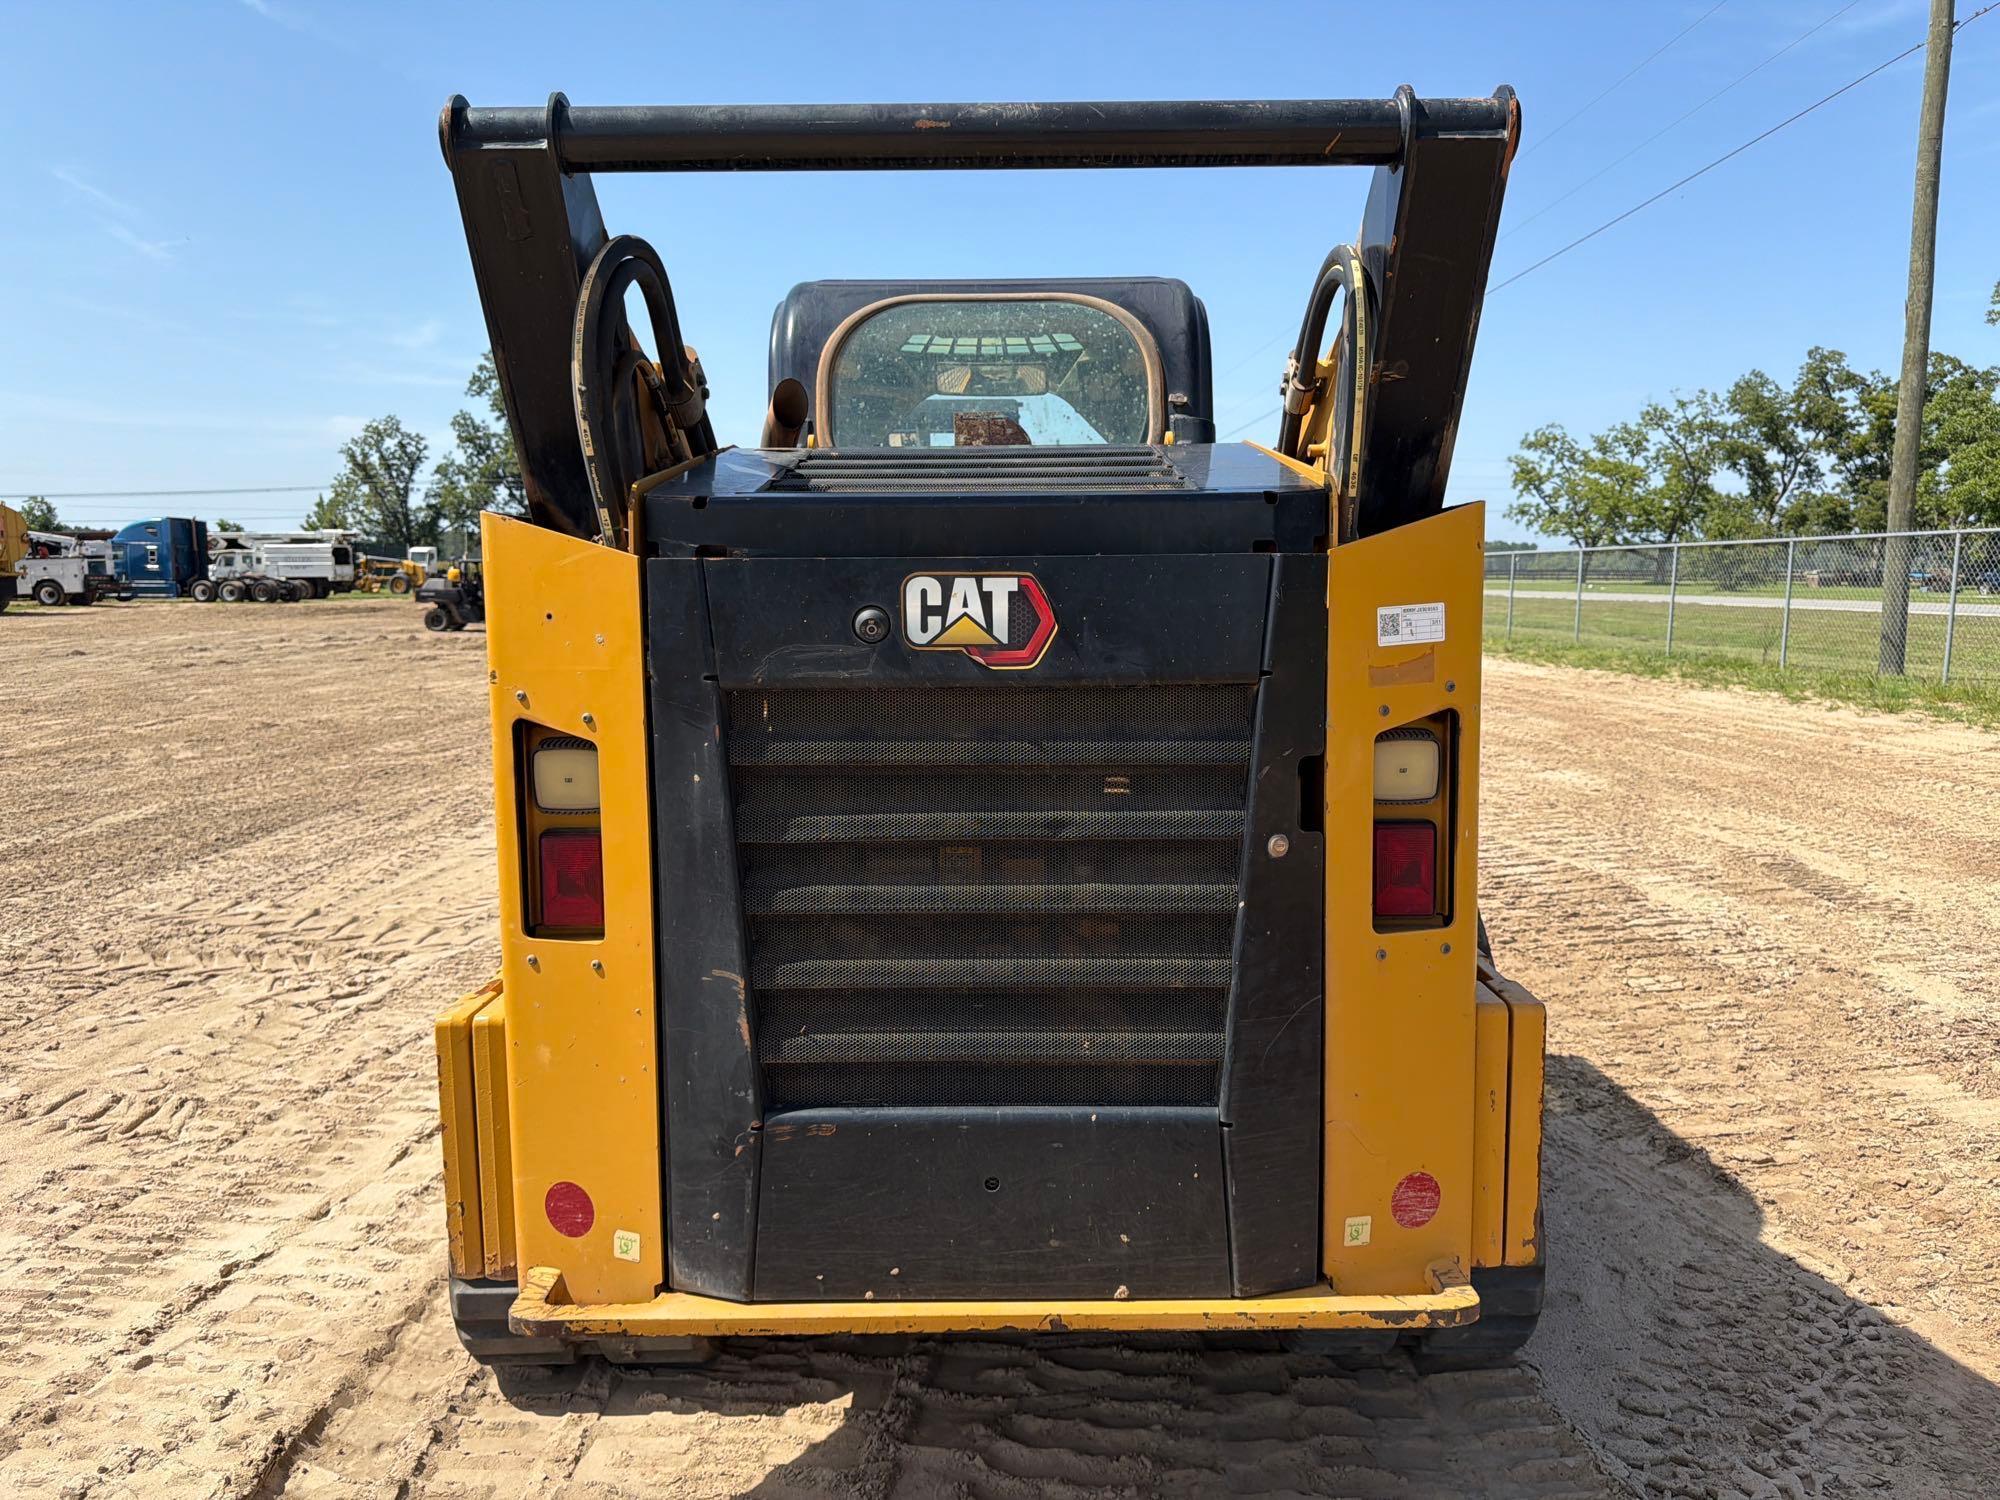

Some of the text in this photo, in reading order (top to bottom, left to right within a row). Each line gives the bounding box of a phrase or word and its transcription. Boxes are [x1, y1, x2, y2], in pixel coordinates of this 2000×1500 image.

[583, 428, 591, 448] 4636
[1350, 471, 1358, 490] 4636
[906, 576, 1019, 645] CAT
